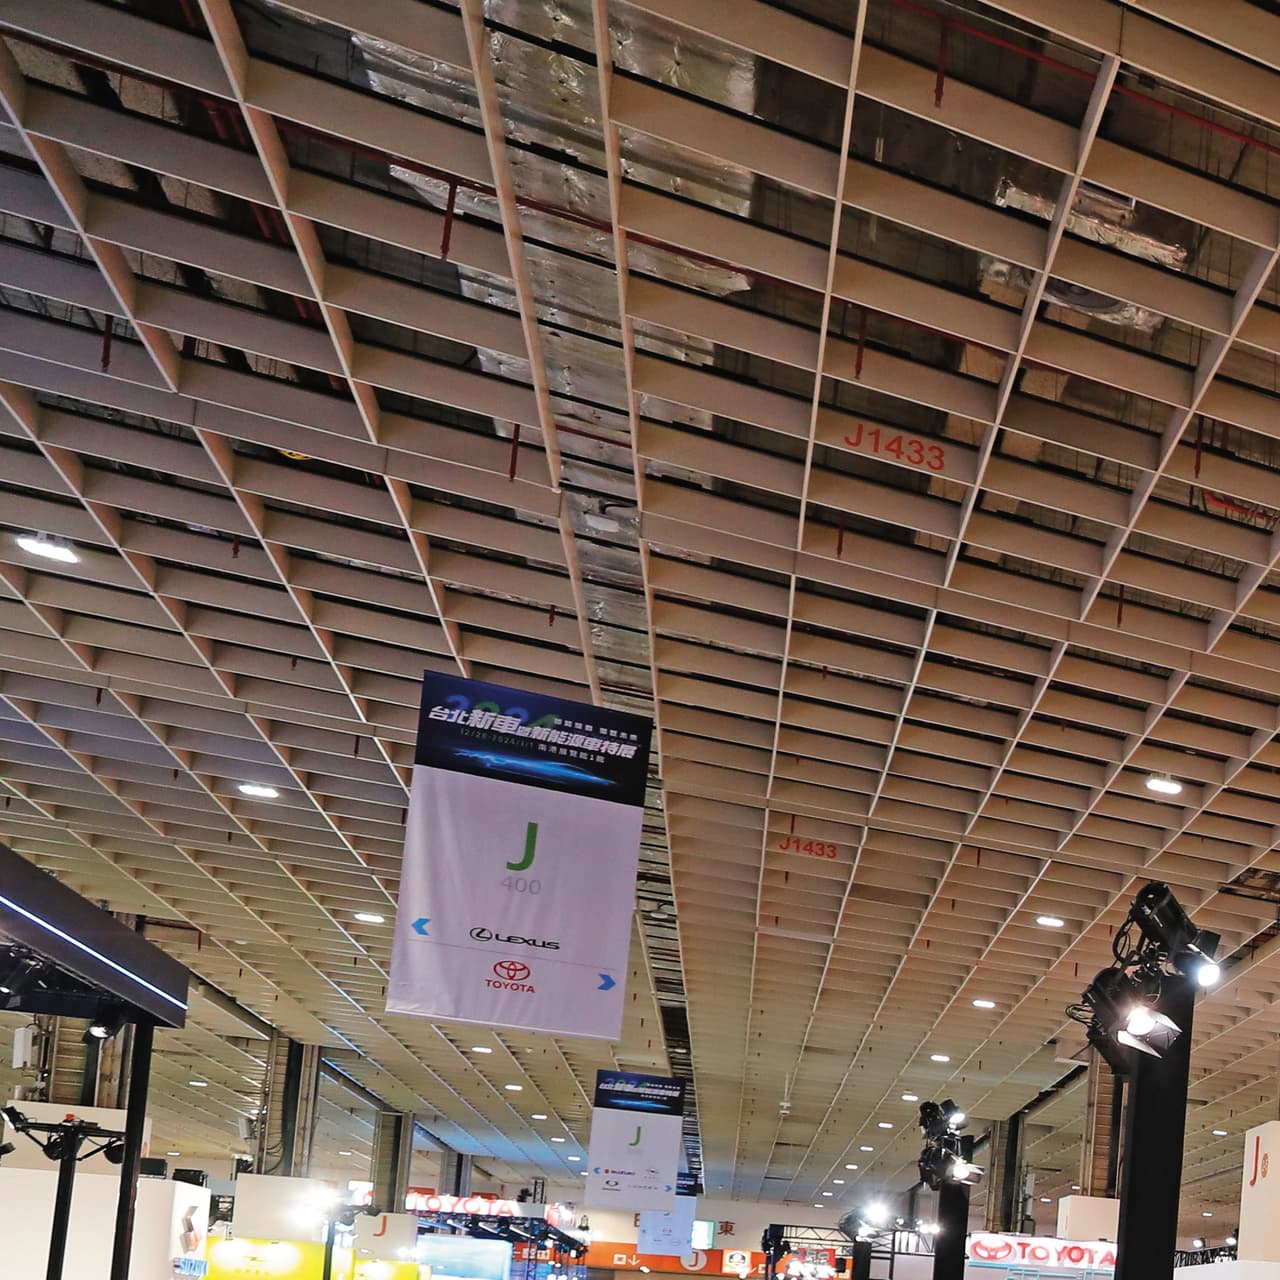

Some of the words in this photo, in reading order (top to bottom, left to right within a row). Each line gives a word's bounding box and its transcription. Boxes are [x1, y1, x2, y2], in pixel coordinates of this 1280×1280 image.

[844, 423, 945, 471] J1433
[505, 821, 539, 872] J
[779, 836, 837, 859] J1433
[502, 875, 542, 896] 400
[495, 933, 561, 951] LEXUS
[484, 978, 536, 994] TOYOTA
[627, 1125, 642, 1147] J
[1249, 1134, 1261, 1187] J
[372, 1215, 388, 1238] J
[717, 1219, 737, 1236] 東
[688, 1251, 699, 1267] J
[1016, 1241, 1117, 1266] TOYOTA
